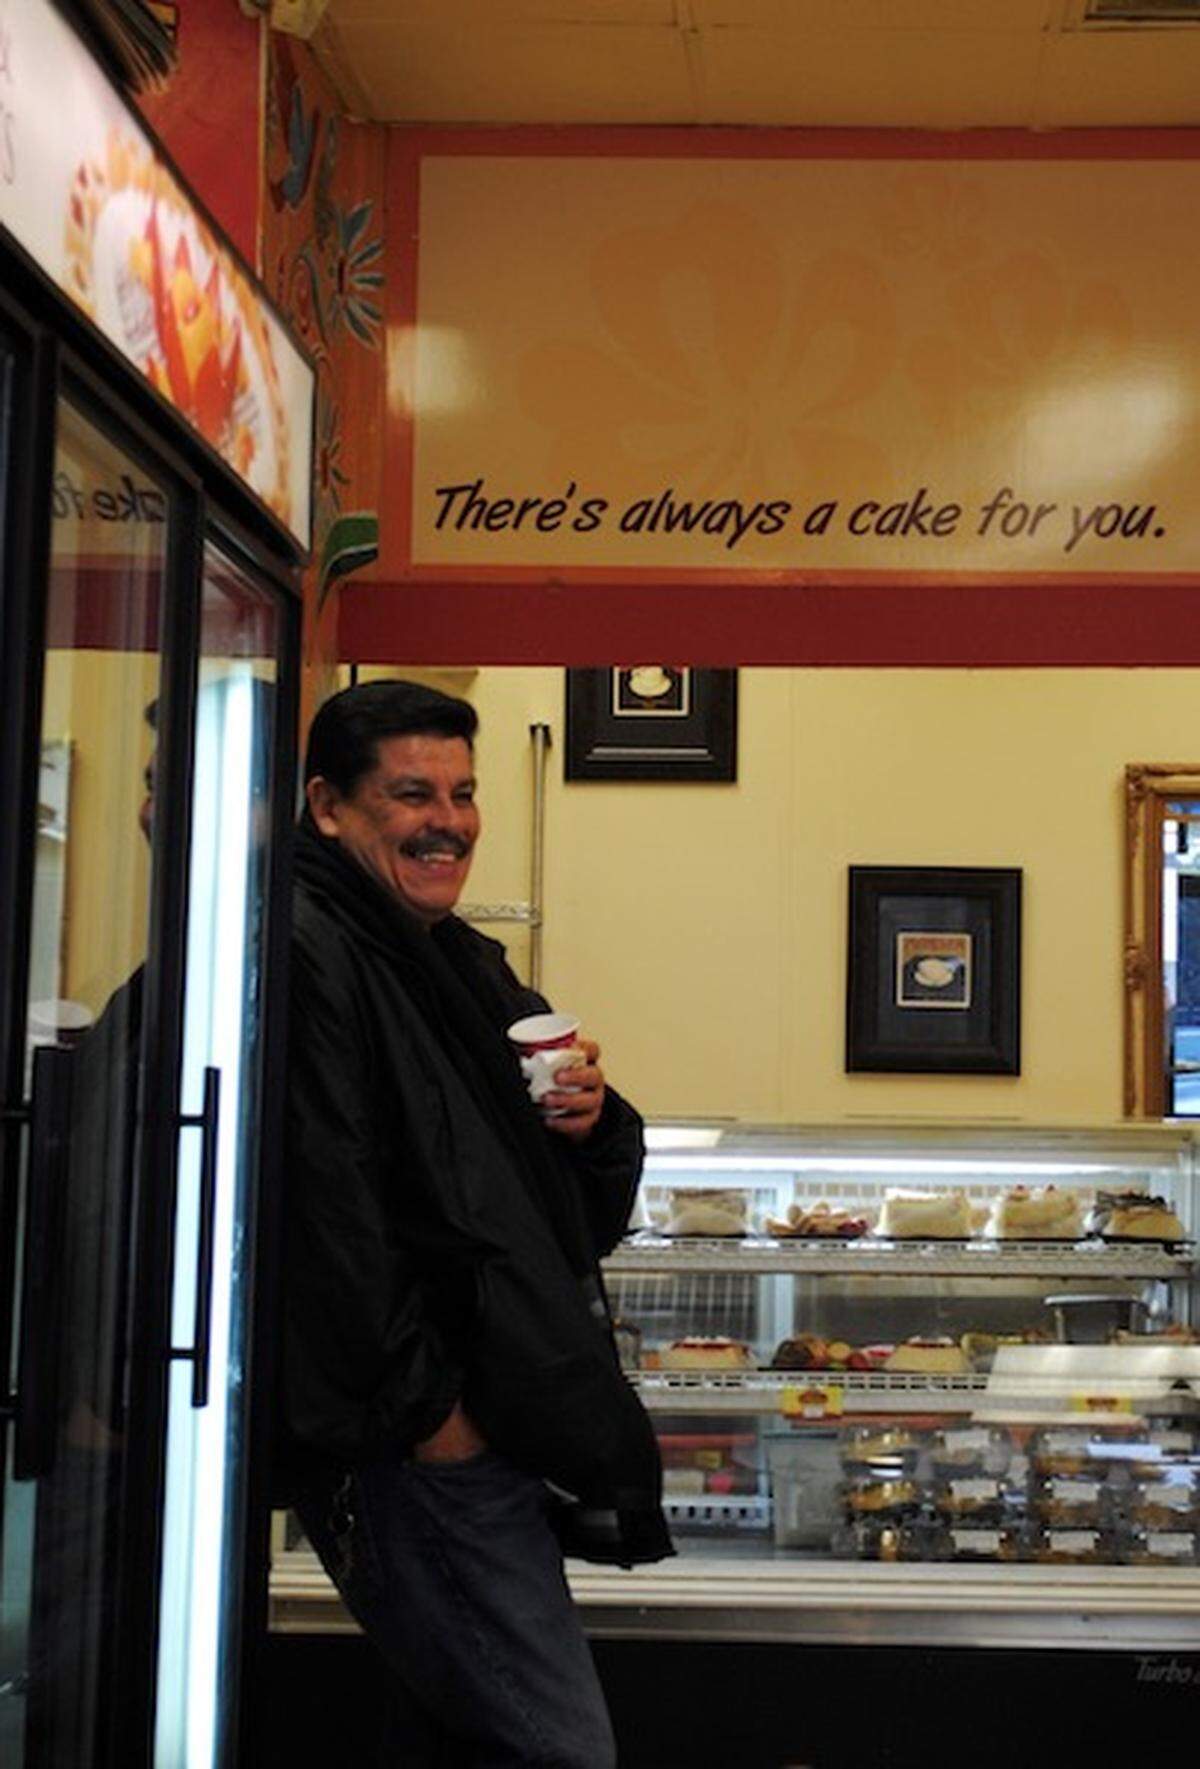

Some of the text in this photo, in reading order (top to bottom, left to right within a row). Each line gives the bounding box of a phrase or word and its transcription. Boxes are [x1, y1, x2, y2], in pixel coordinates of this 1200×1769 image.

[435, 480, 1167, 553] There's always a cake for you.
